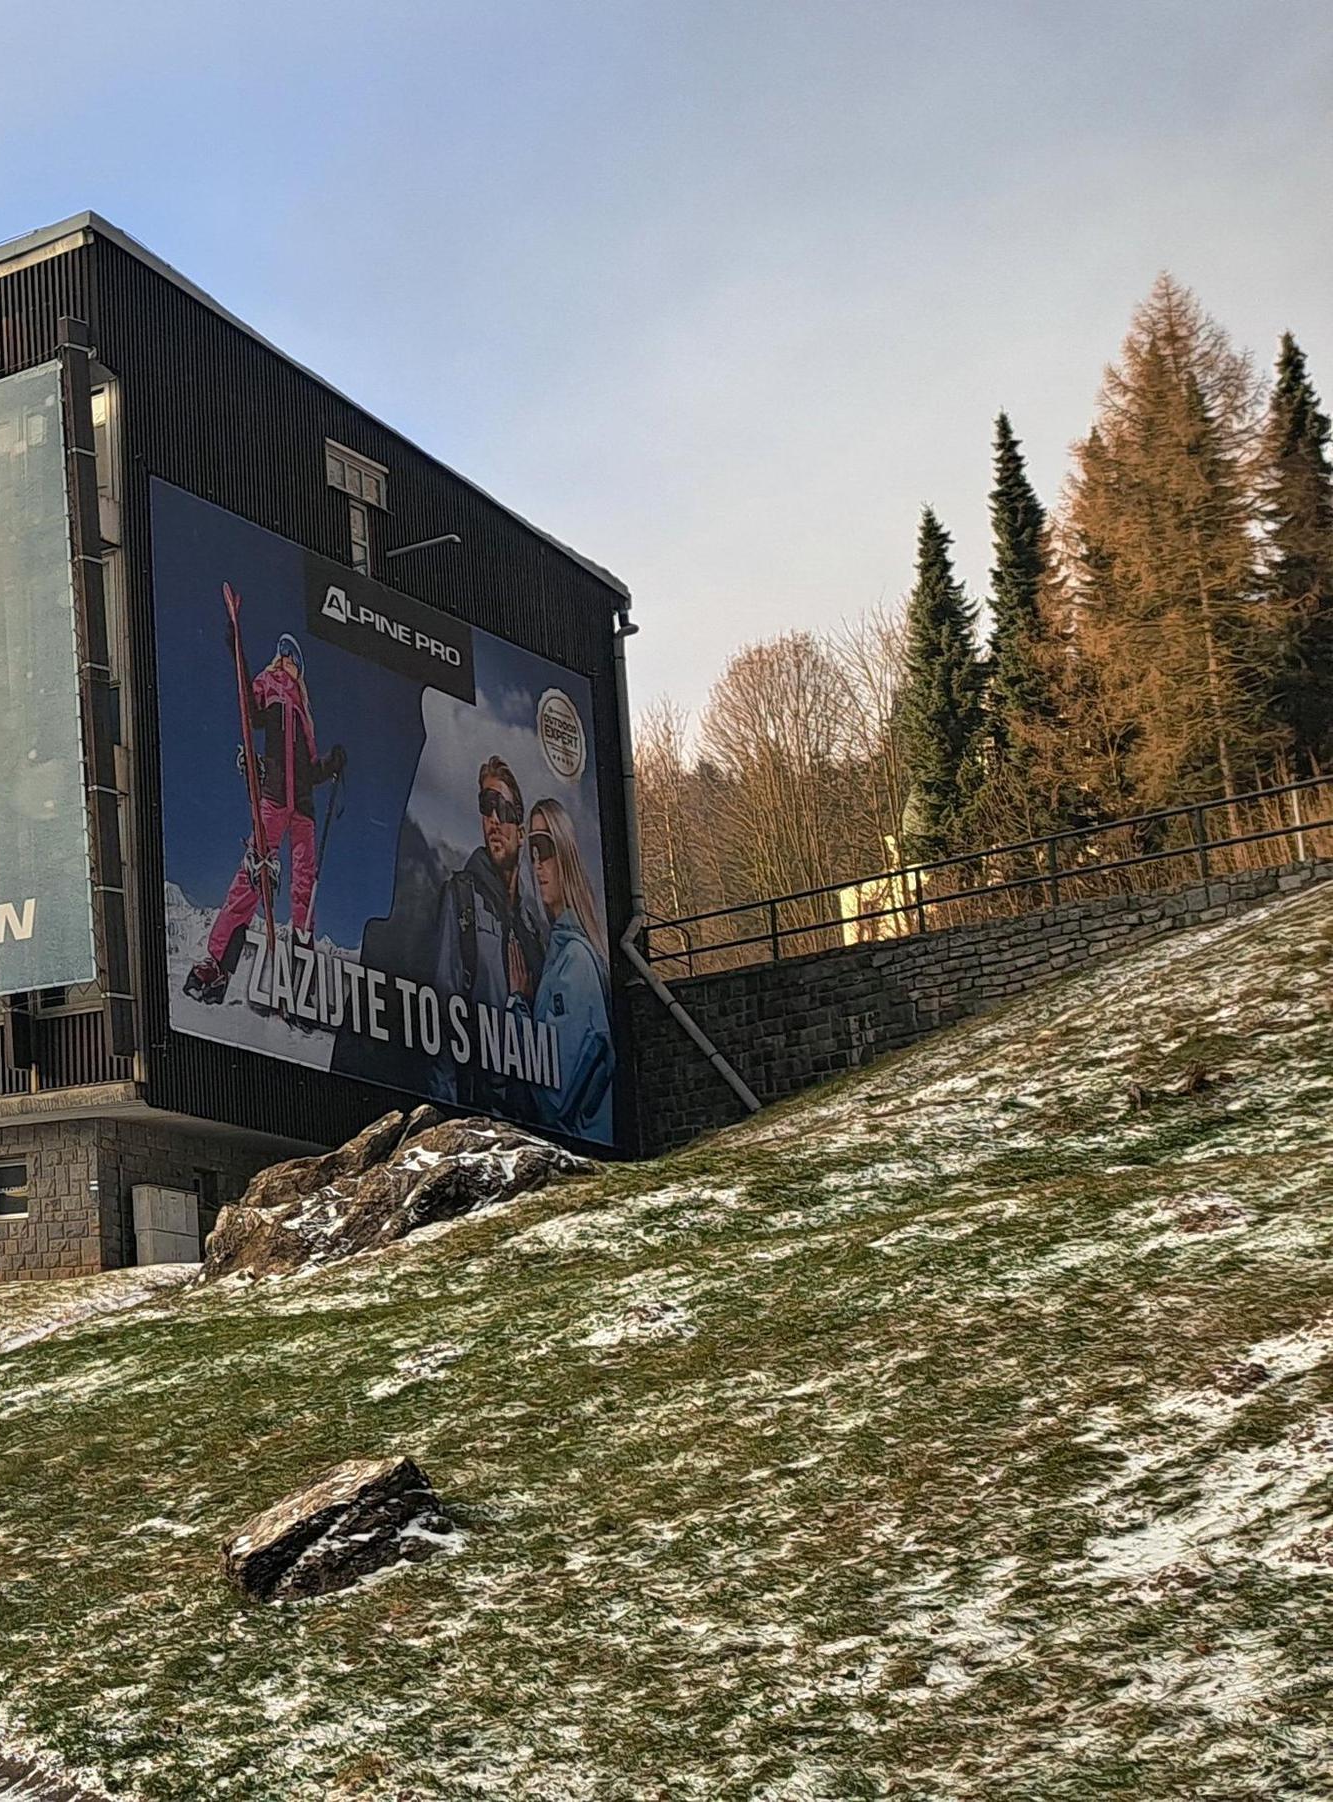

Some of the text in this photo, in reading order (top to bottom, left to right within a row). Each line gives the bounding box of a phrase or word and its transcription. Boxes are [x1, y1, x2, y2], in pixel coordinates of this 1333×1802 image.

[321, 585, 461, 667] ALPINE PRO
[544, 725, 578, 749] EXPERT
[244, 927, 561, 1089] ZAŽIJTE TO S NÁMI
